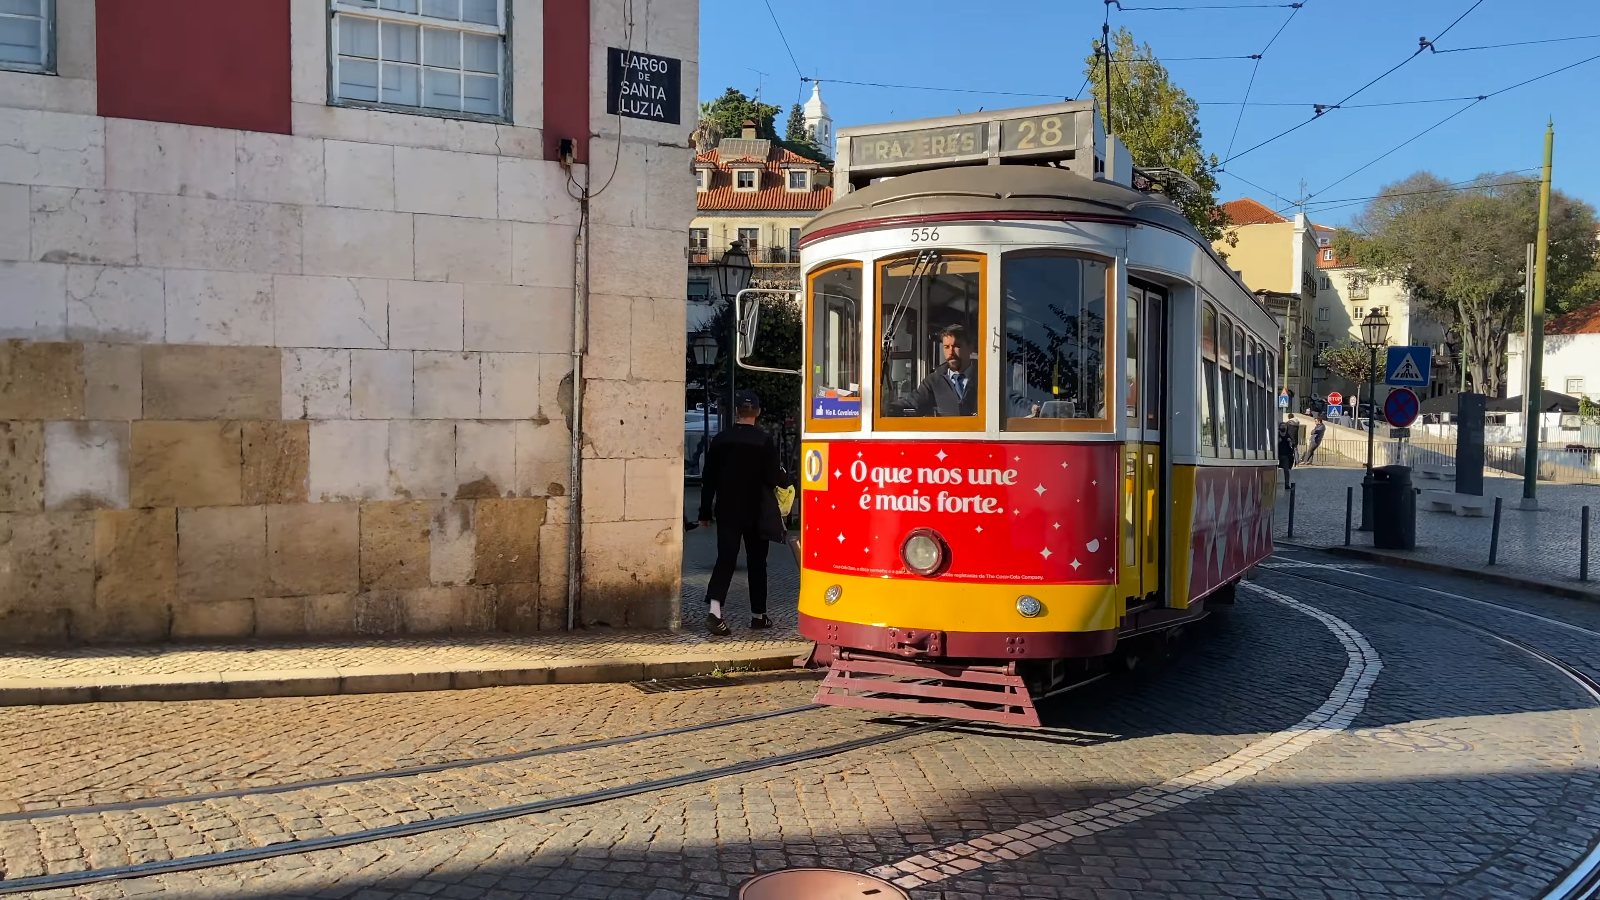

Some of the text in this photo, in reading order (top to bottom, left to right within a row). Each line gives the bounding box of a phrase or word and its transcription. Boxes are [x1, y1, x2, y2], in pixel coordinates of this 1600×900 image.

[621, 53, 668, 73] LARGO
[638, 71, 651, 82] DE
[621, 80, 666, 101] SANTA
[621, 98, 664, 118] LUZIA
[1017, 117, 1063, 150] 28
[861, 132, 975, 161] PRAZERES
[911, 227, 940, 242] 556
[870, 466, 913, 488] que
[917, 466, 963, 485] nos
[967, 467, 1018, 486] une
[859, 486, 1004, 514] é mais forte.
